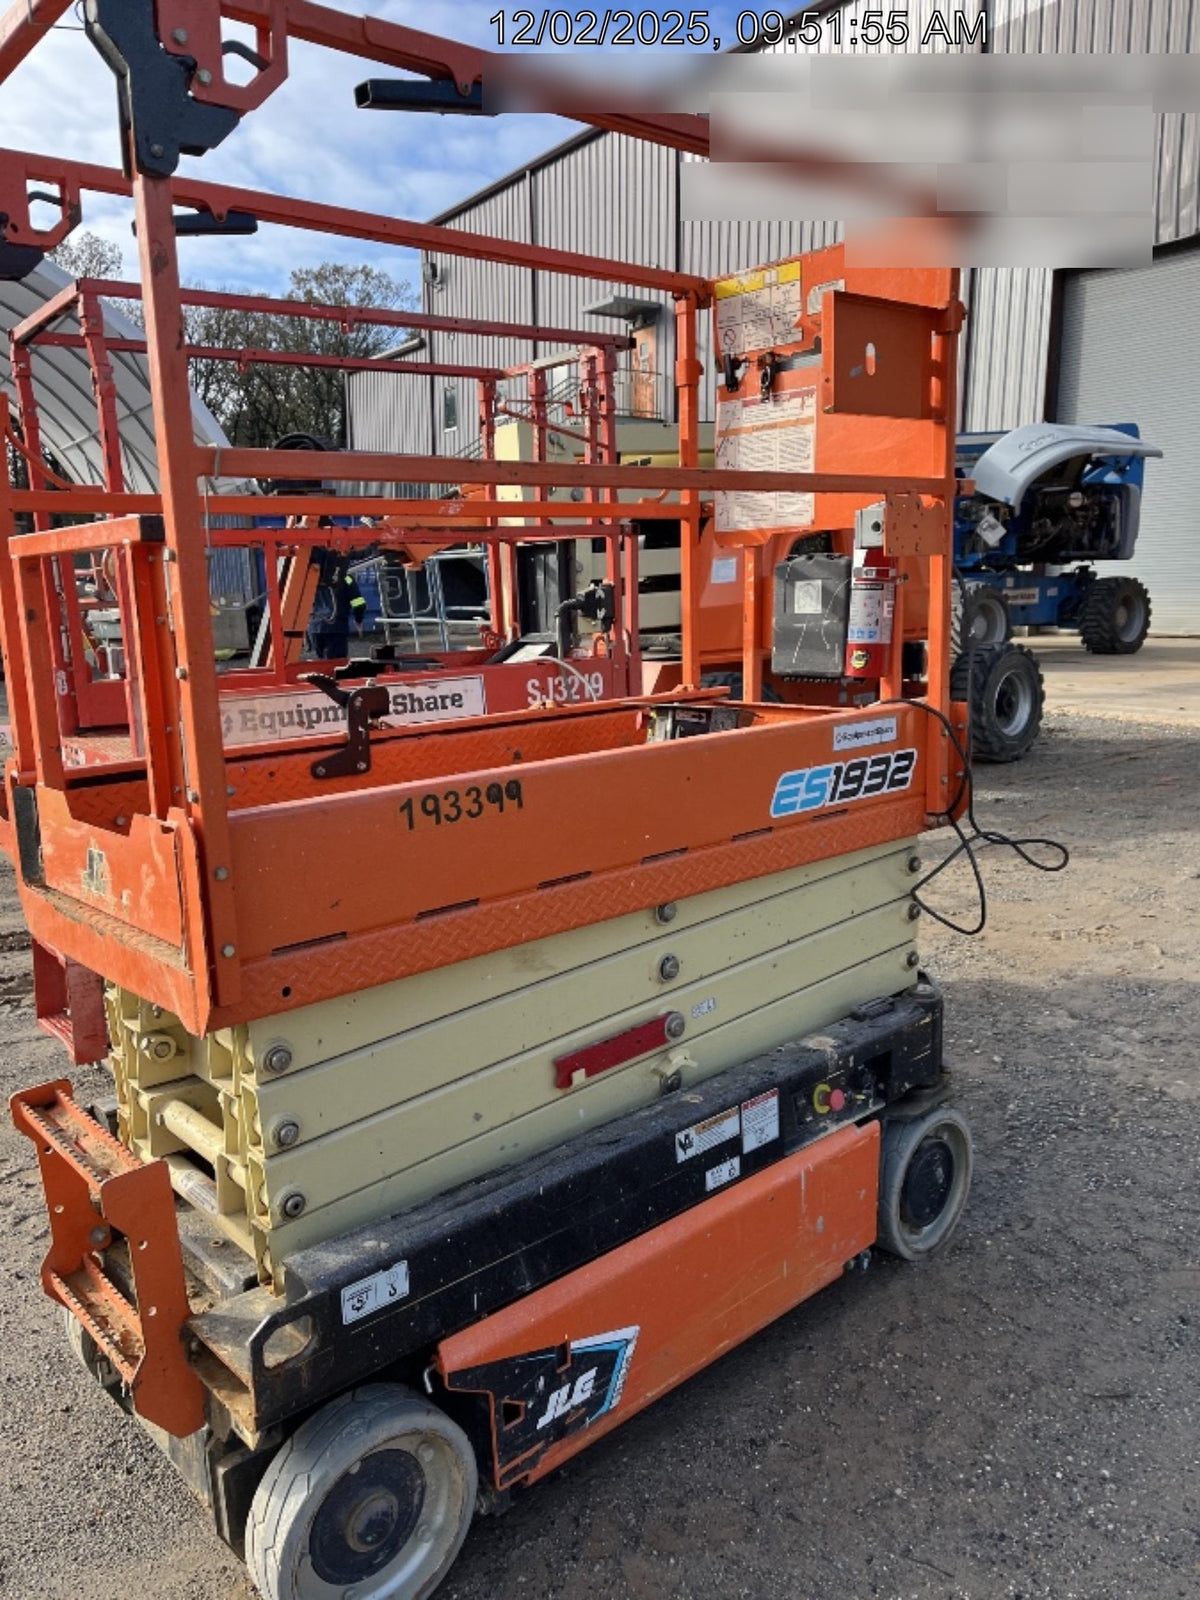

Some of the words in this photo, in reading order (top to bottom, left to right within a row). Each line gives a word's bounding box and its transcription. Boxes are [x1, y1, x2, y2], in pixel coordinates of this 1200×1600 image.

[527, 672, 603, 705] SJ3219
[400, 779, 523, 830] 193399
[771, 749, 917, 817] ES1932
[536, 1366, 598, 1430] JLG
